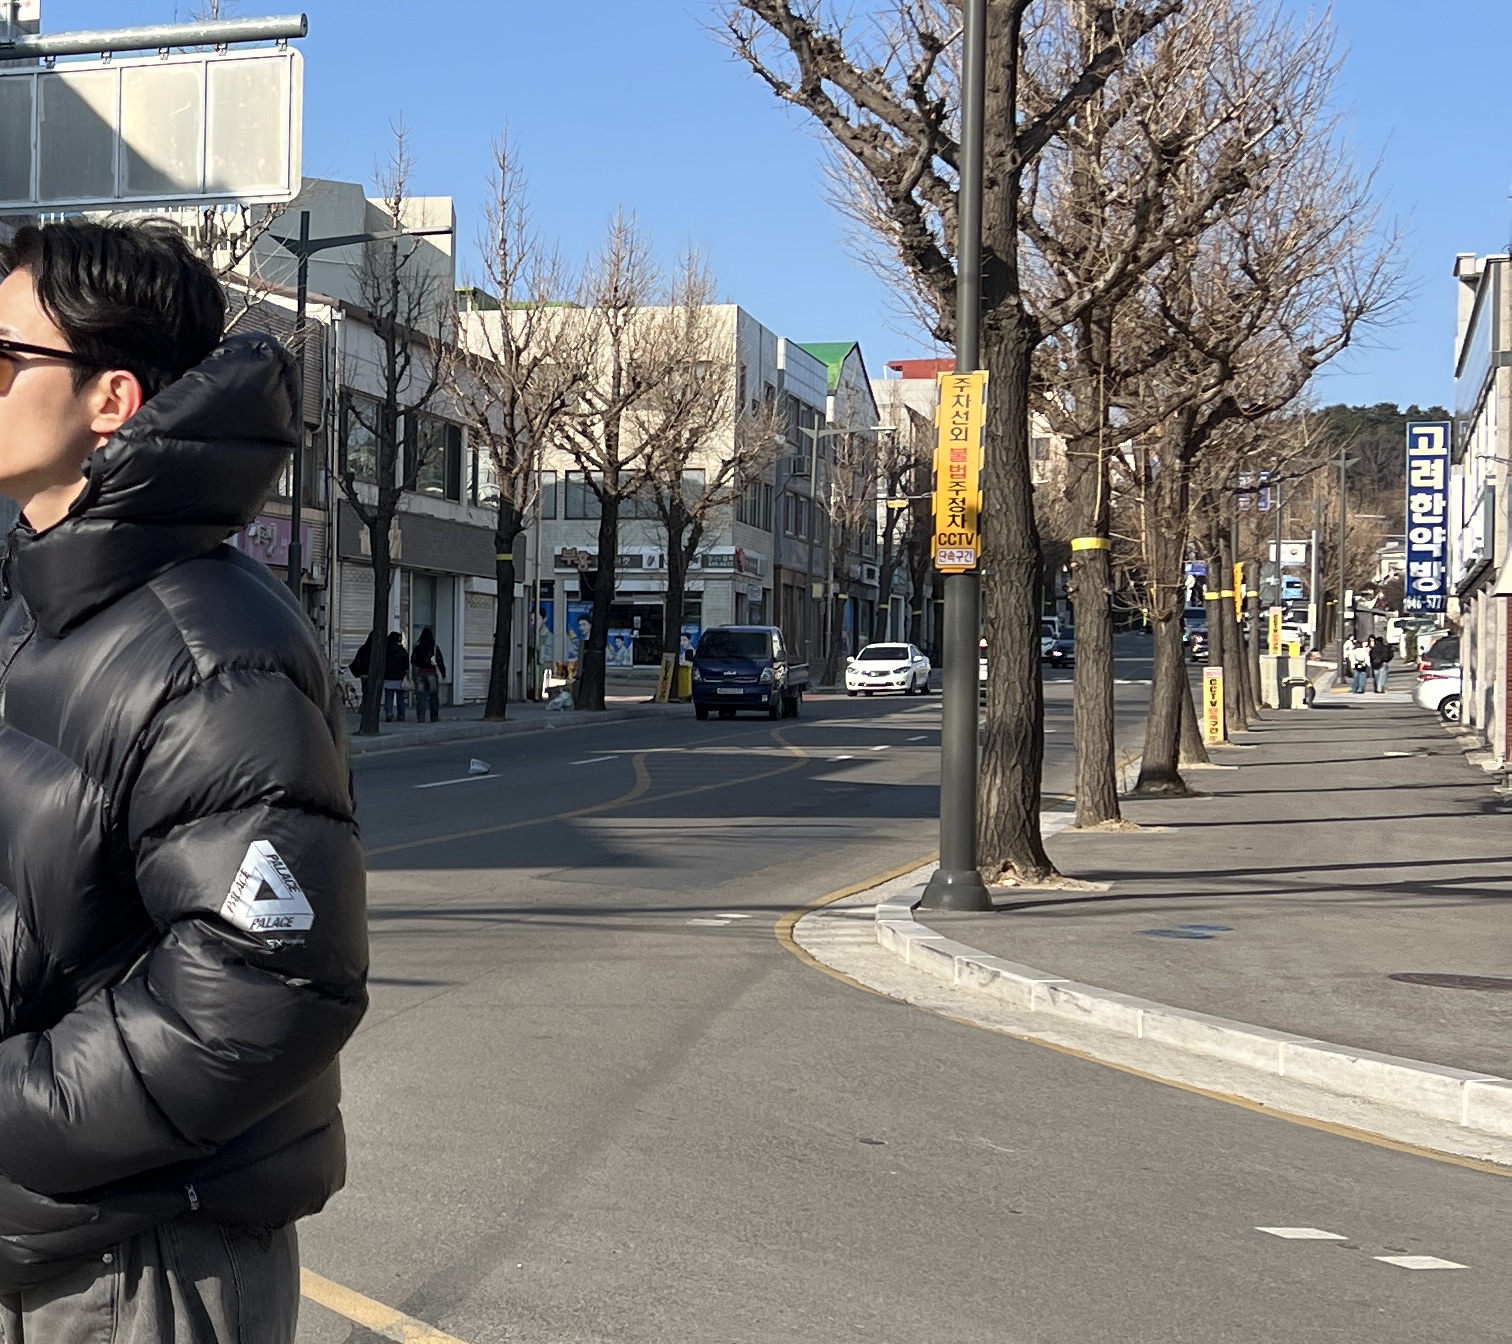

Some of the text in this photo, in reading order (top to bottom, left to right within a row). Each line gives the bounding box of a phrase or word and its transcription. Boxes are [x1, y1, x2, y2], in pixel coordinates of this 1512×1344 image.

[946, 377, 972, 530] 주차선외 불법주정차
[1409, 426, 1448, 593] 고려한약방
[938, 532, 975, 546] CCTV
[938, 550, 973, 563] 단속구간
[226, 867, 252, 914] PALACE
[265, 853, 301, 894] PALACE
[249, 916, 295, 930] PALACE
